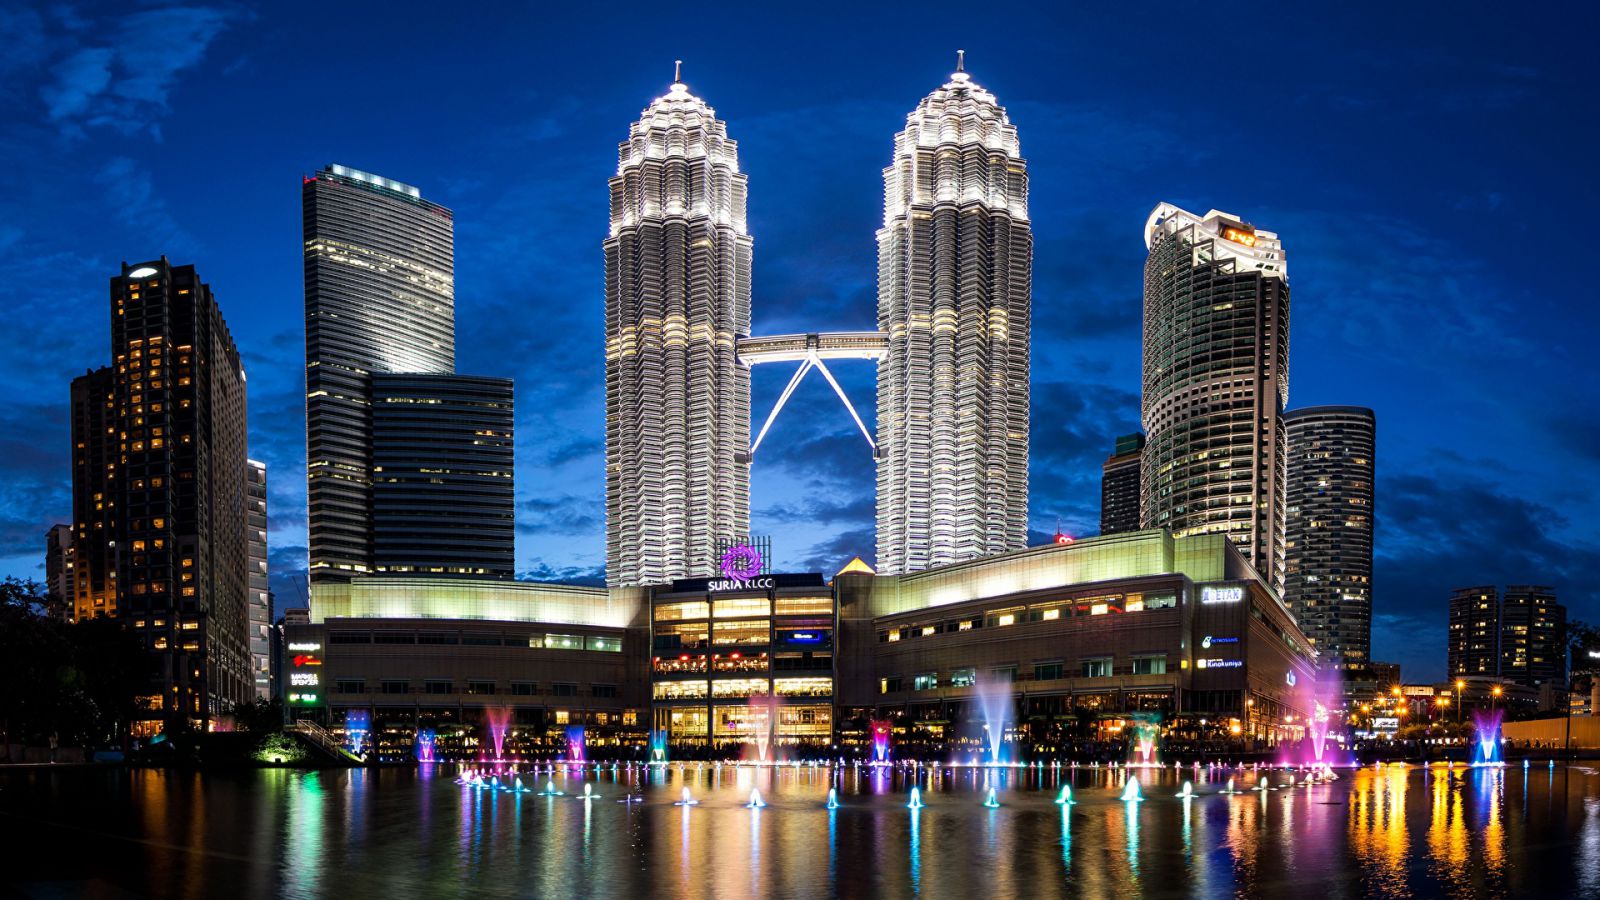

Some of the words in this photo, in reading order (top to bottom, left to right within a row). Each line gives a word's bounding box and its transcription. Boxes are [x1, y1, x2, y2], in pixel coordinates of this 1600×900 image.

[1228, 230, 1255, 246] 7:42
[708, 580, 742, 591] SURIA
[745, 578, 773, 589] KLCC
